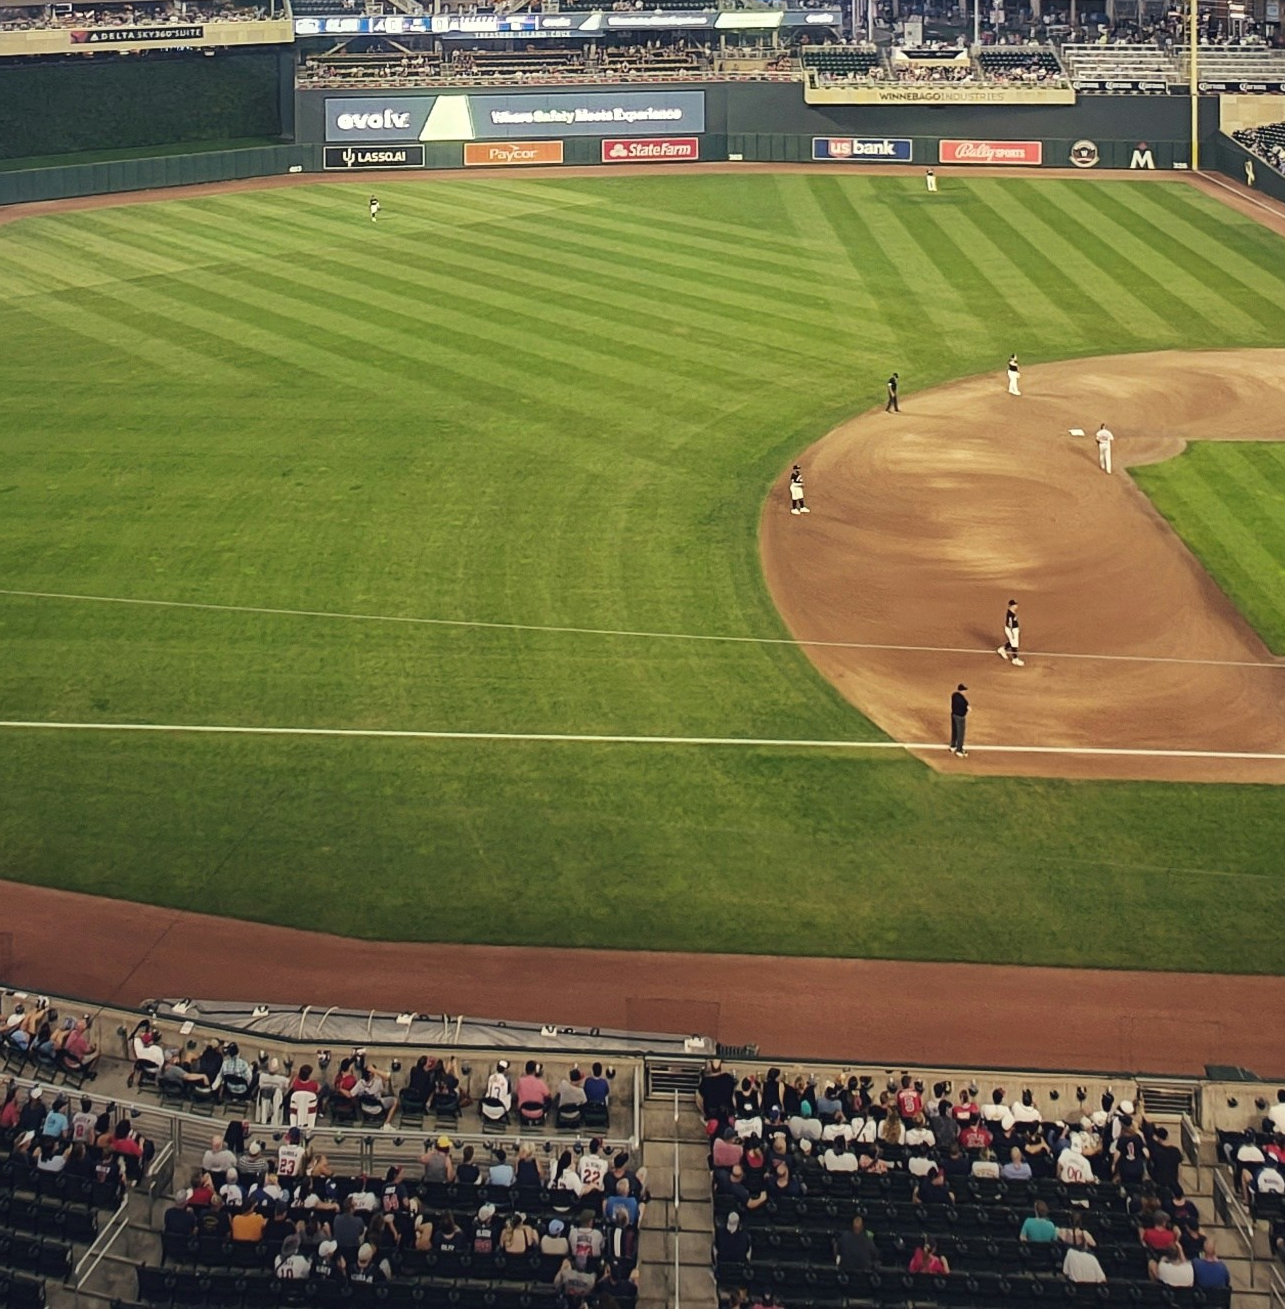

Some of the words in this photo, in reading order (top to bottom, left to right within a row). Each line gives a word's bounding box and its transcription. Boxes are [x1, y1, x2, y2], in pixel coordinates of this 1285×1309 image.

[101, 29, 136, 40] DELTA
[880, 92, 941, 101] WINNEBAGO
[940, 92, 1004, 101] INDUSTRIES
[533, 109, 575, 125] Safety
[613, 107, 683, 123] Experience
[490, 146, 537, 162] Paycor
[830, 143, 851, 155] us
[853, 141, 896, 155] bank
[955, 143, 995, 161] Bally
[994, 149, 1026, 158] SPORTS
[358, 151, 405, 163] LASSO.AI
[1130, 150, 1156, 170] M
[280, 1159, 296, 1175] 23
[583, 1169, 601, 1186] 22
